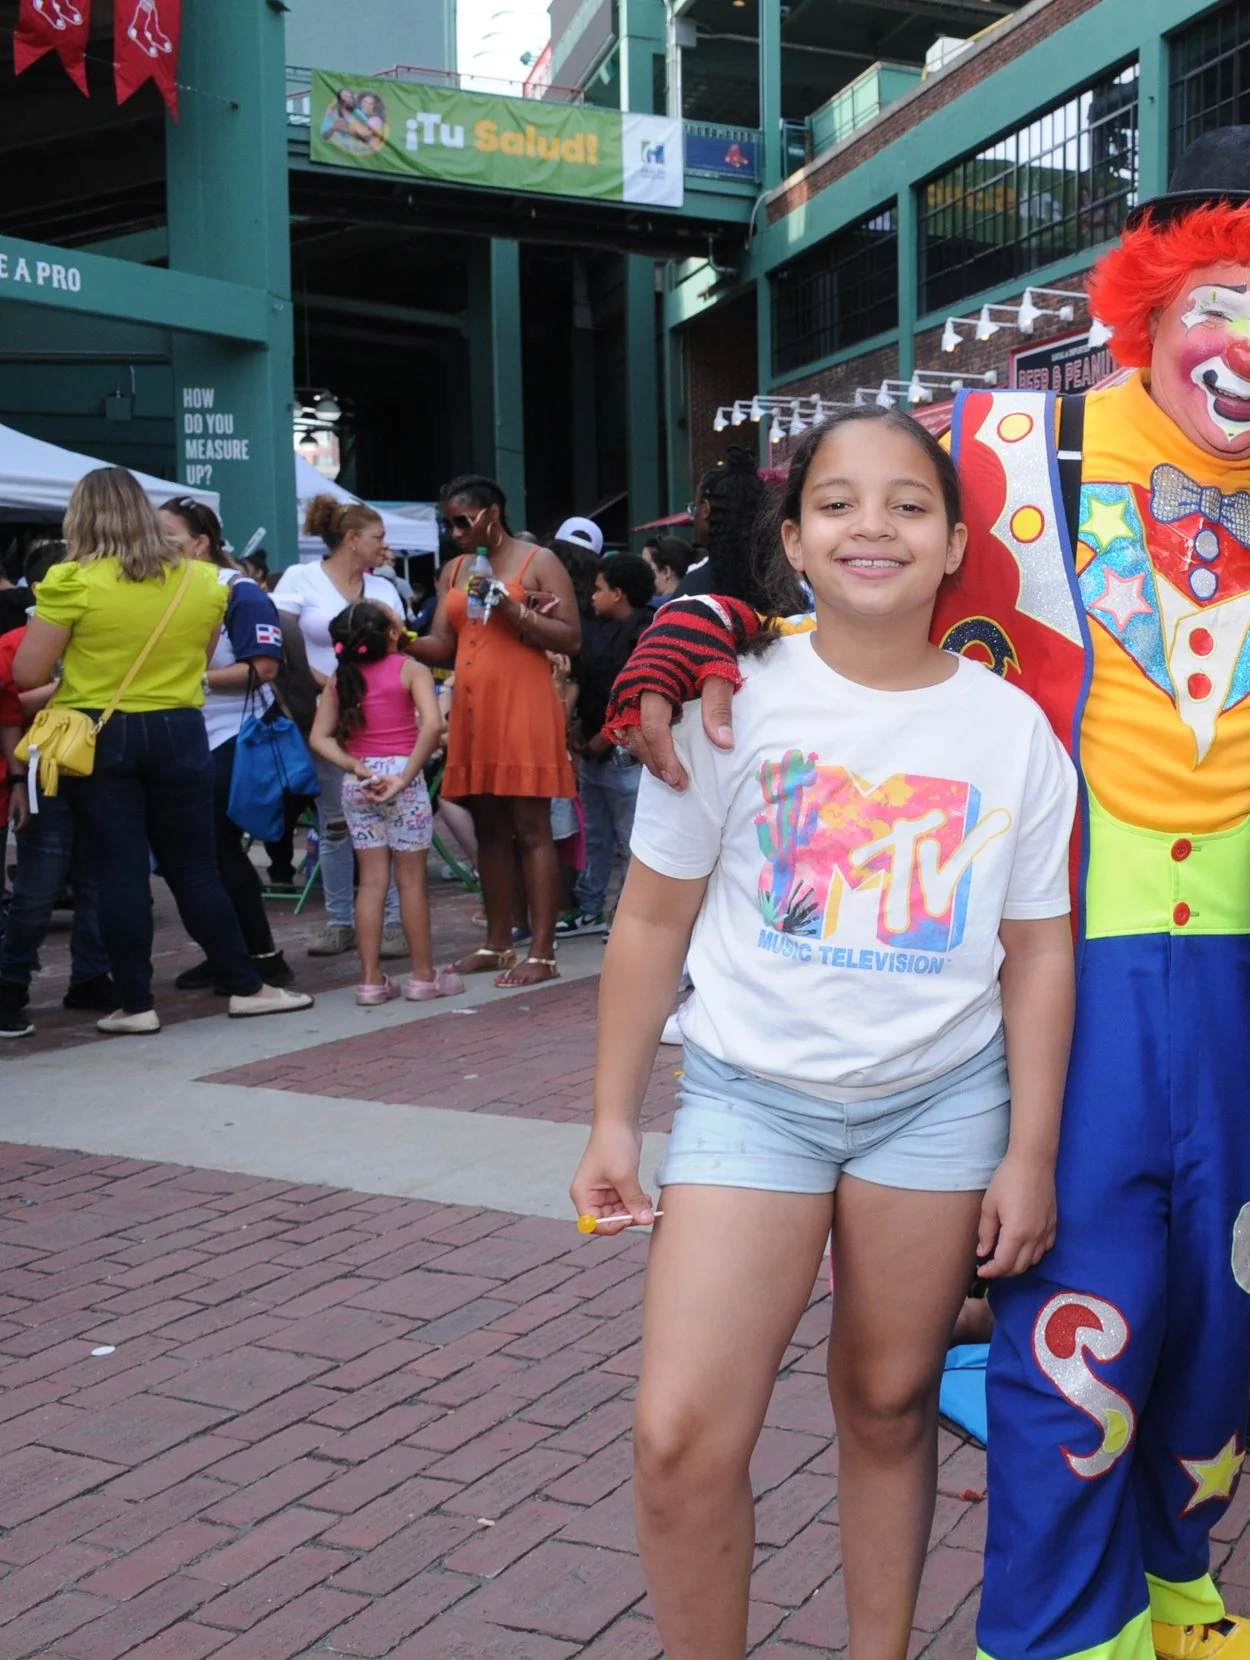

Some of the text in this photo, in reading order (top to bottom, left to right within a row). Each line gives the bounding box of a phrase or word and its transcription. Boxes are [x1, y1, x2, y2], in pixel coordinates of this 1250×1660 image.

[405, 111, 599, 165] ¡Tu Salud!
[14, 257, 32, 284] A
[36, 260, 81, 292] PRO
[1018, 368, 1049, 390] BEER
[1052, 365, 1062, 393] &
[183, 388, 215, 408] HOW
[184, 413, 234, 434] DO YOU
[185, 439, 250, 460] MEASURE
[186, 464, 213, 485] UP?
[756, 762, 1012, 952] MTV
[757, 929, 944, 975] MUSIC TELEVISION
